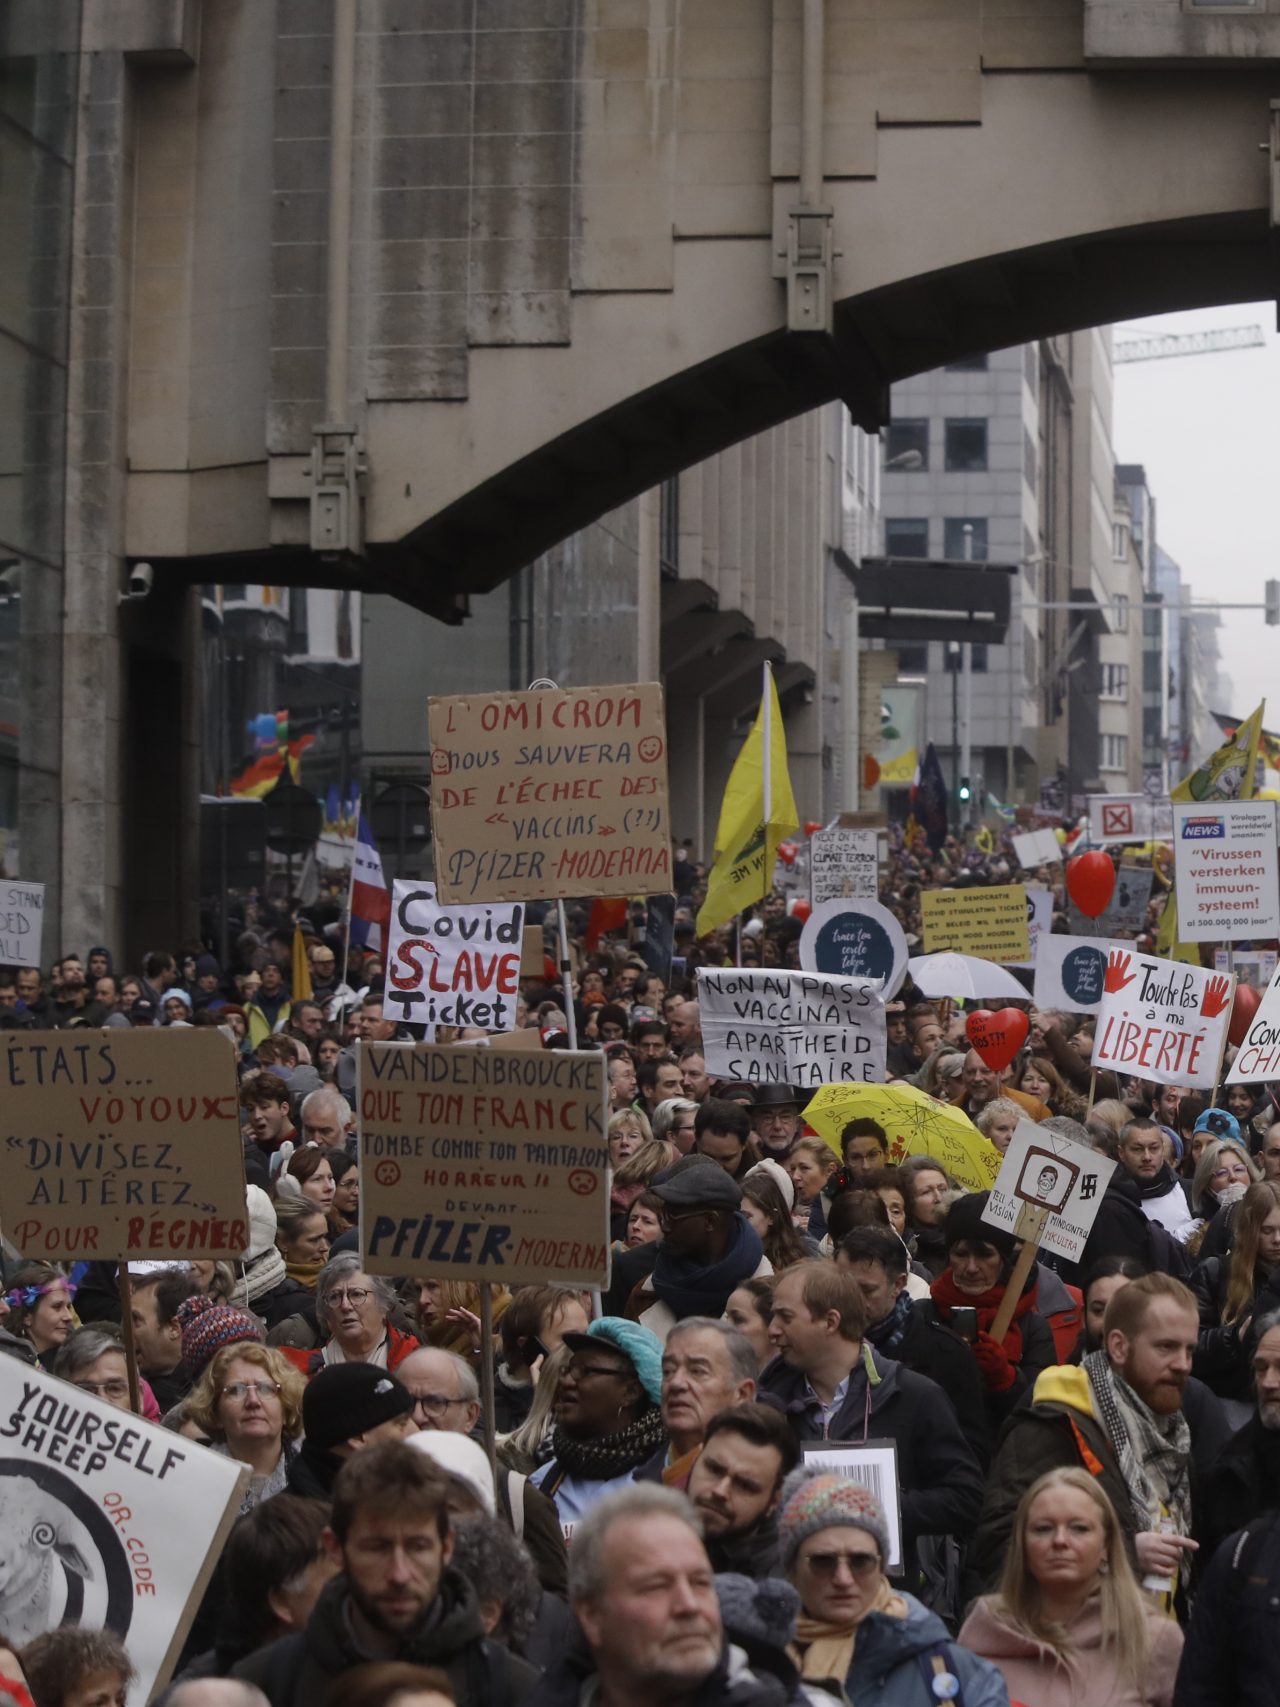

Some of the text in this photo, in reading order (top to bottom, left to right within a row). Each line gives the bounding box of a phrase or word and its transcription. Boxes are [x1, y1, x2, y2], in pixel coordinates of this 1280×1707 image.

[515, 742, 631, 765] SAUVERA
[442, 776, 658, 809] DE L'ÉCHEC DES
[1185, 825, 1220, 837] NEWS
[1231, 822, 1272, 830] wereldwijd
[1190, 864, 1265, 878] versterken
[924, 904, 1025, 918] COVID STIMULATING TICKET
[963, 893, 1010, 903] DEMOCRATIE
[1198, 898, 1259, 914] systeem!
[398, 890, 522, 944] Covid
[970, 942, 1022, 951] PROFESSOREN
[390, 938, 521, 994] SLAVE
[763, 977, 791, 999] AU
[802, 977, 872, 1006] PASS
[1166, 1013, 1185, 1026] ma
[368, 1048, 603, 1090] VANDENBROUCKE
[361, 1088, 604, 1134] QUE TON FRANCK
[361, 1131, 426, 1157] TOMBE
[489, 1140, 516, 1161] TON
[424, 1168, 526, 1188] HORREUR
[13, 1219, 100, 1251] POUR
[0, 1411, 107, 1476] SHEEP
[17, 1381, 186, 1479] YOURSELF
[103, 1492, 156, 1597] QR-CODE
